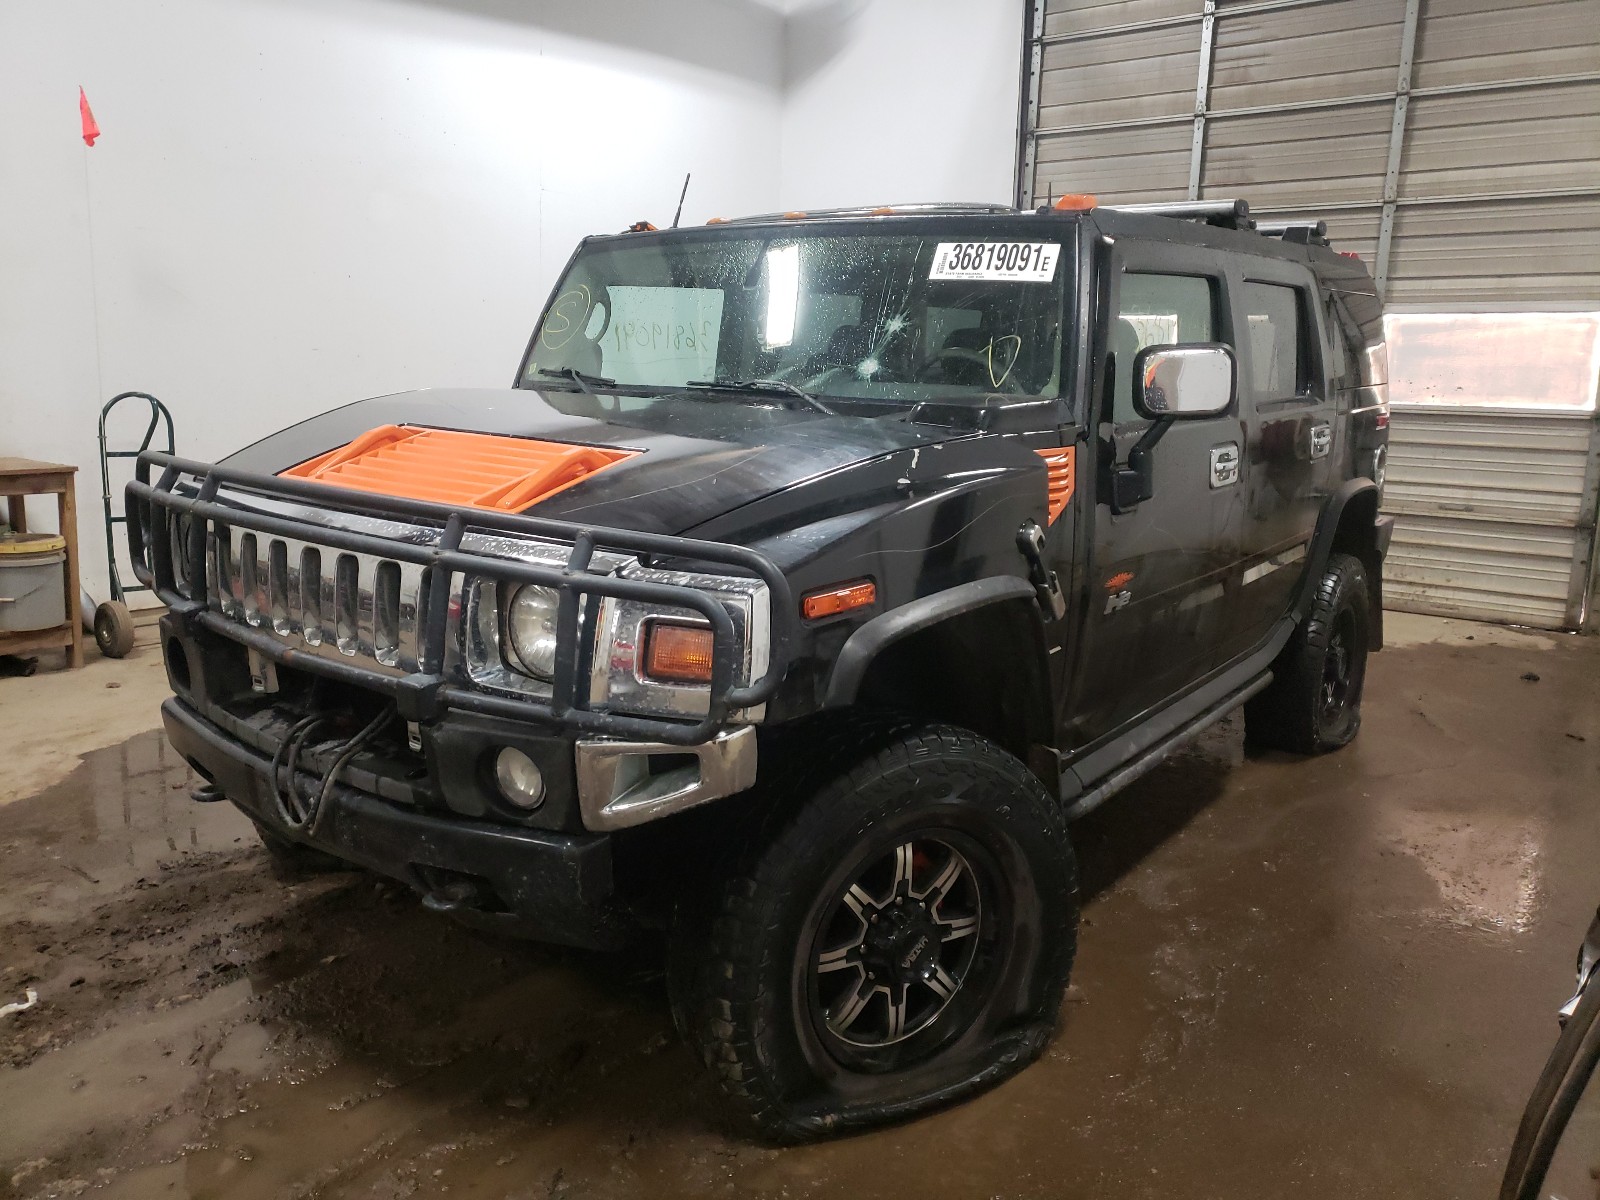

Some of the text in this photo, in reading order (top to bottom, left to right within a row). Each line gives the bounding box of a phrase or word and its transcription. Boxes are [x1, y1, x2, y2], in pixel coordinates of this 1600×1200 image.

[949, 244, 1043, 271] 36819091
[1104, 590, 1132, 615] H2
[902, 935, 928, 968] ULTRA
